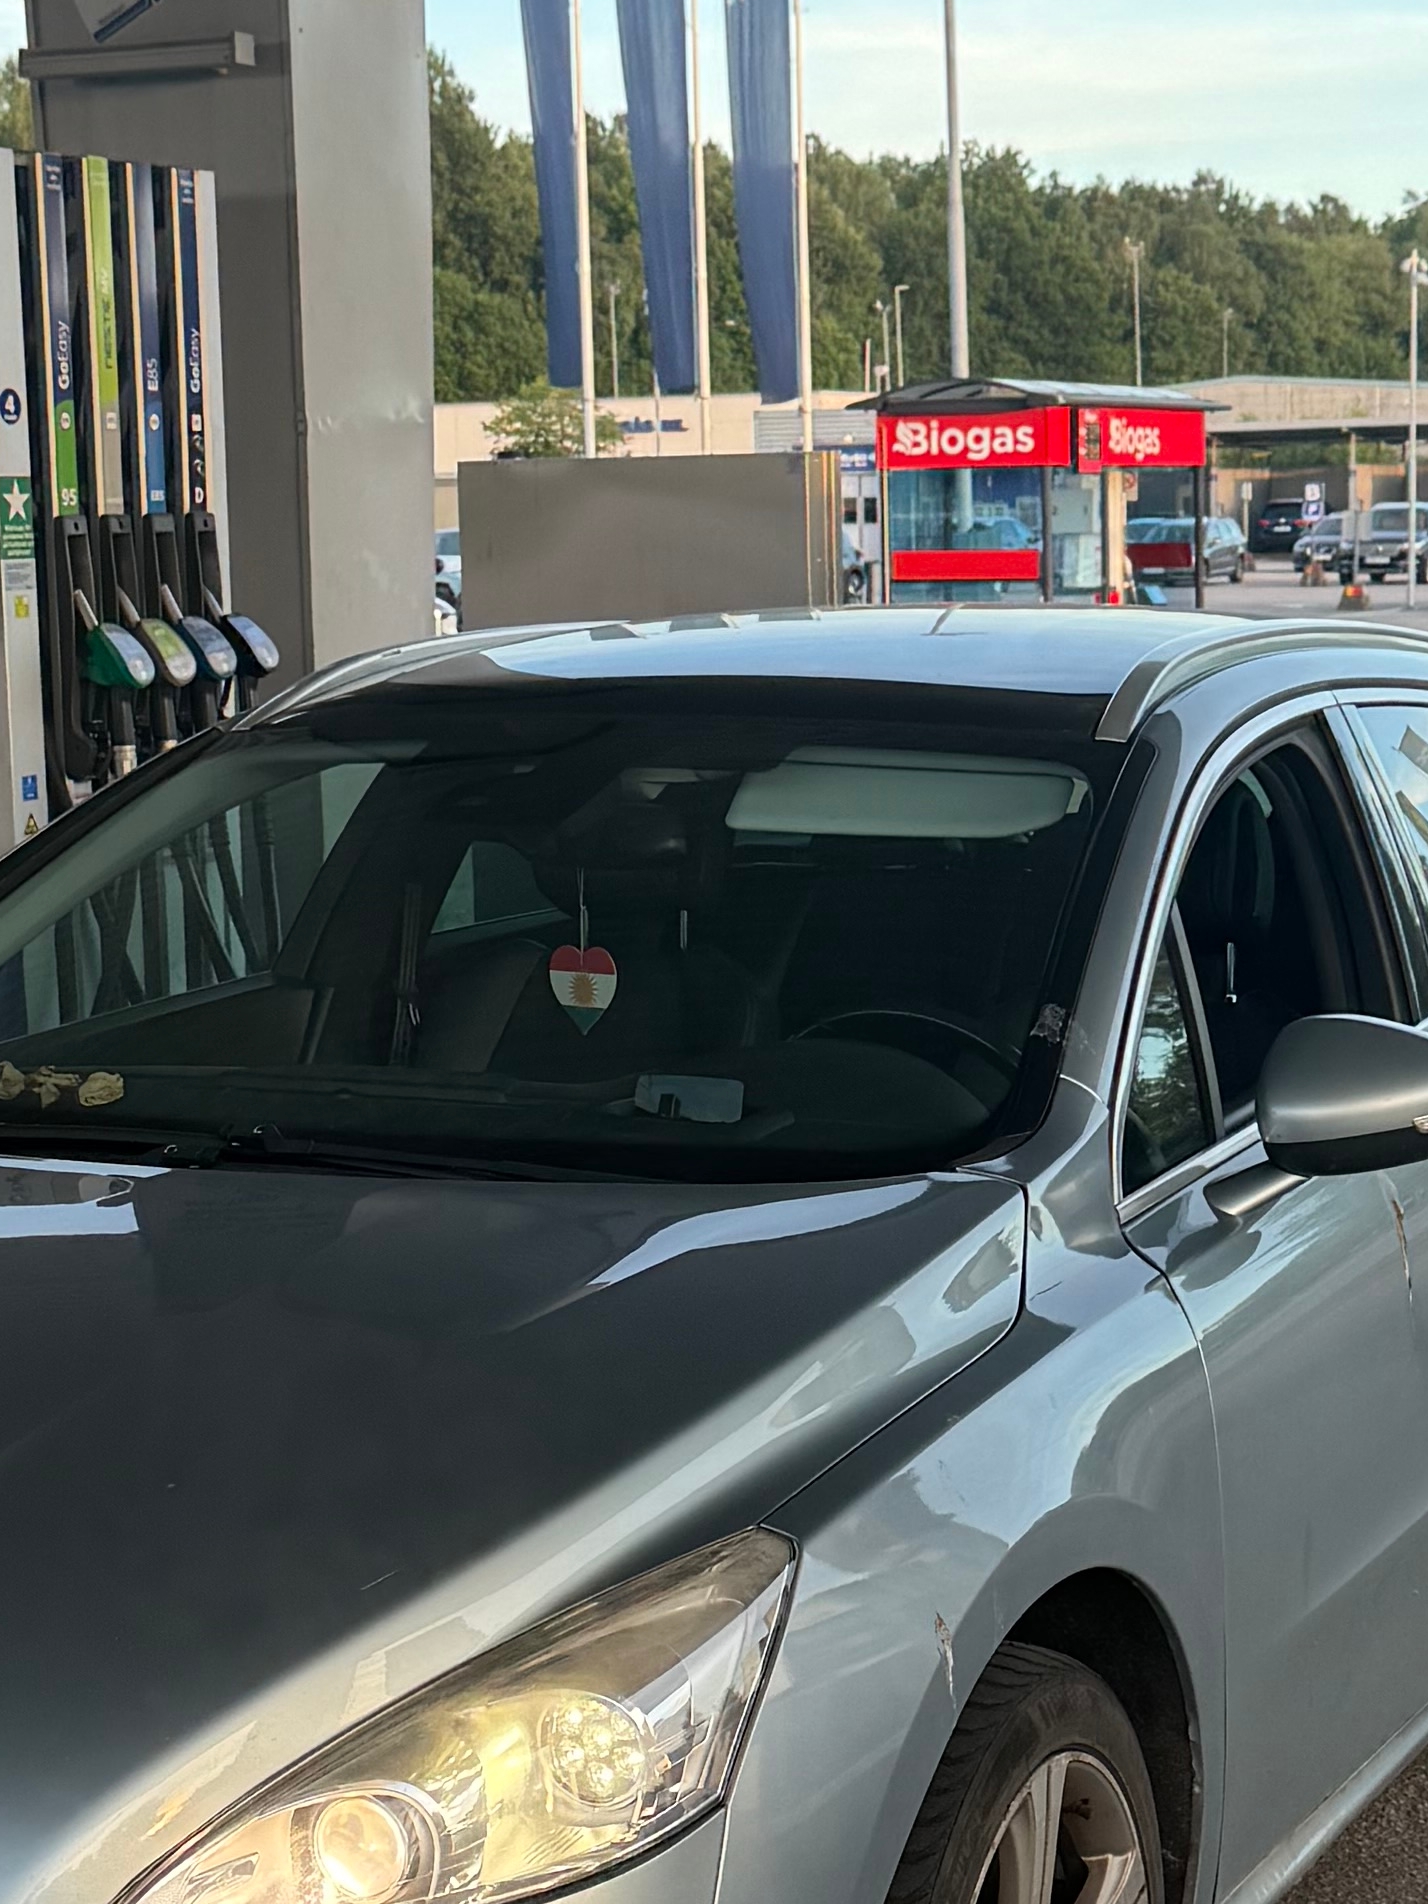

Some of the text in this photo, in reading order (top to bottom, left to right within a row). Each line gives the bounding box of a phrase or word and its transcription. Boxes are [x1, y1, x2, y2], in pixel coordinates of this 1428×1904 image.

[57, 320, 72, 391] GoEasy
[146, 357, 161, 392] E85
[189, 327, 202, 394] GoEasy
[4, 393, 15, 414] 4
[895, 416, 1036, 461] Biogas
[1109, 416, 1162, 462] Biogas
[61, 487, 78, 506] 95
[194, 487, 204, 504] D
